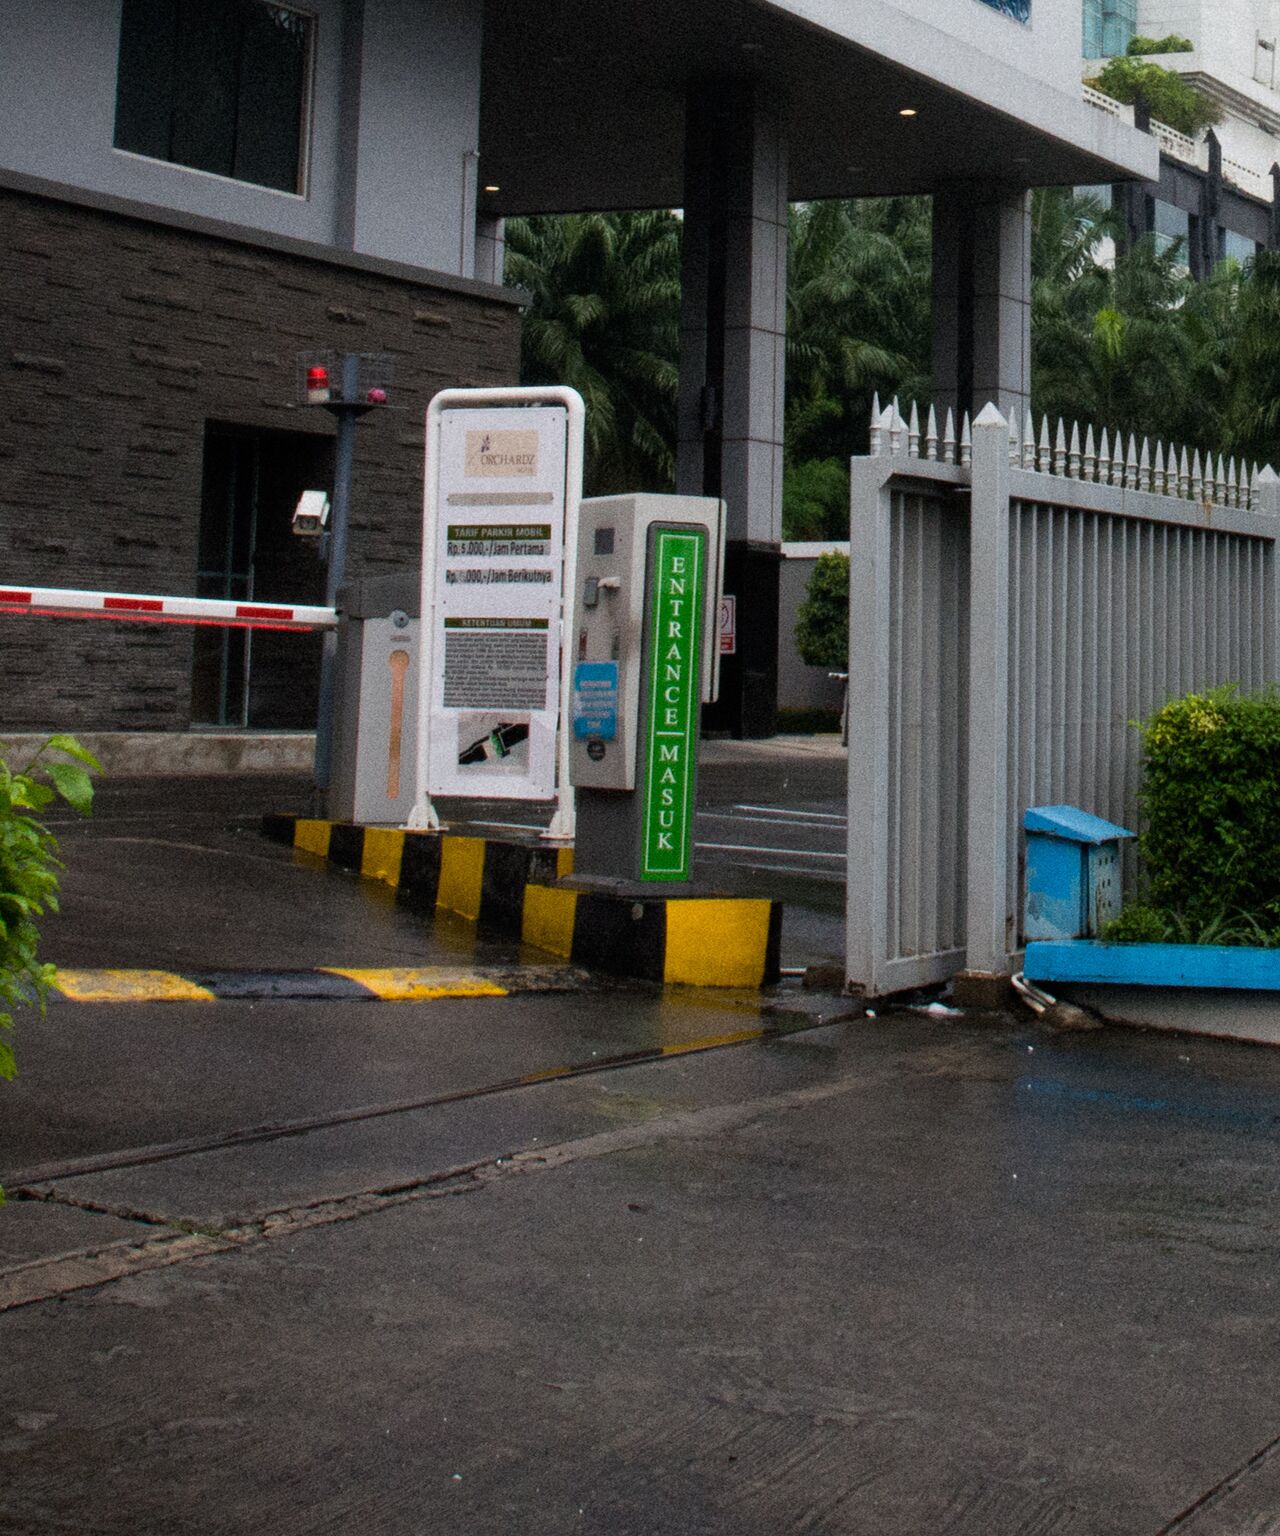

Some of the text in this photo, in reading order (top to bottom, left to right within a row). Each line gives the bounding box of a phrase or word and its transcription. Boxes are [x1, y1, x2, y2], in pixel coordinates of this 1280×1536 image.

[480, 454, 535, 466] ORCHARDZ
[481, 527, 513, 537] PARKIR
[510, 542, 545, 555] Pertama
[508, 569, 552, 584] Berikutnya
[664, 556, 686, 725] ENTRANCE
[657, 744, 679, 850] MASUK
